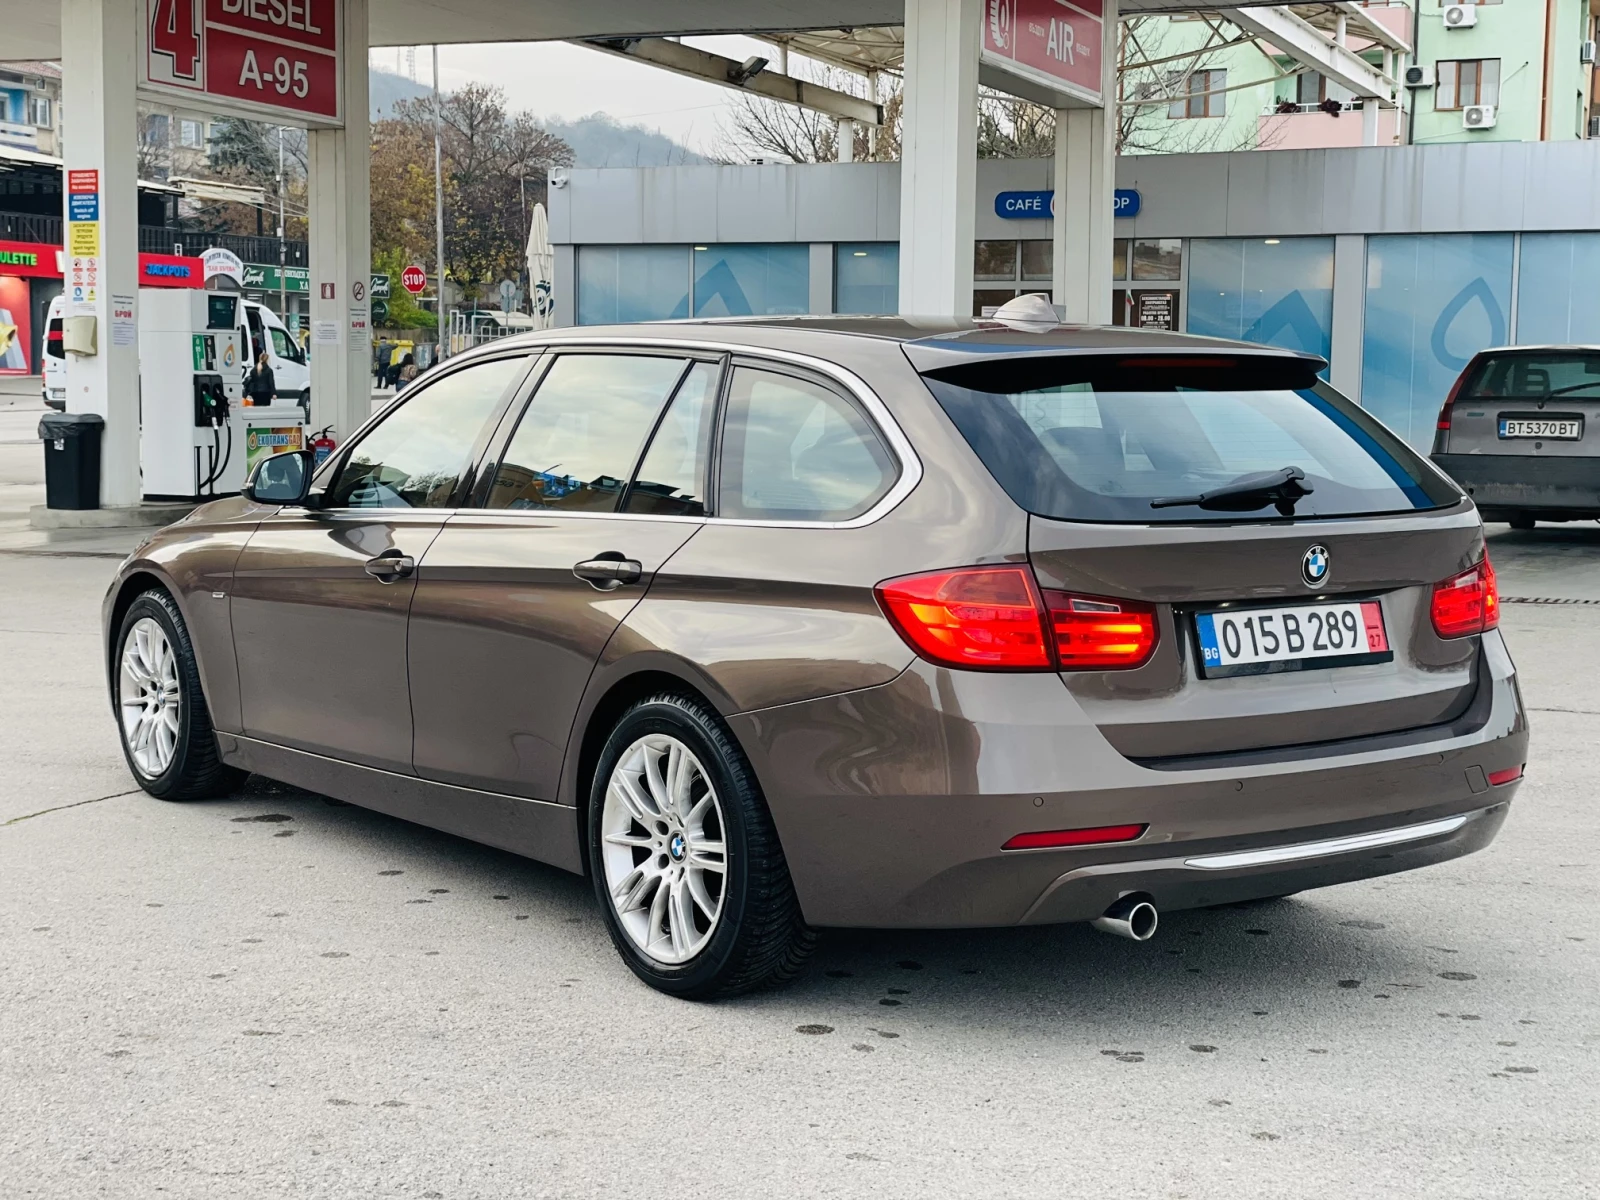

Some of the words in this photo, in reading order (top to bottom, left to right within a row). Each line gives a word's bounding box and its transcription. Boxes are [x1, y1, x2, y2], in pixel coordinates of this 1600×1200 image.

[151, 0, 201, 81] 4
[1046, 17, 1075, 66] AIR
[238, 49, 309, 98] A-95
[1005, 196, 1042, 211] CAFÉ
[1114, 197, 1130, 210] OP
[146, 263, 191, 278] JACKPOTS
[404, 274, 424, 286] STOP
[1204, 647, 1219, 660] BG
